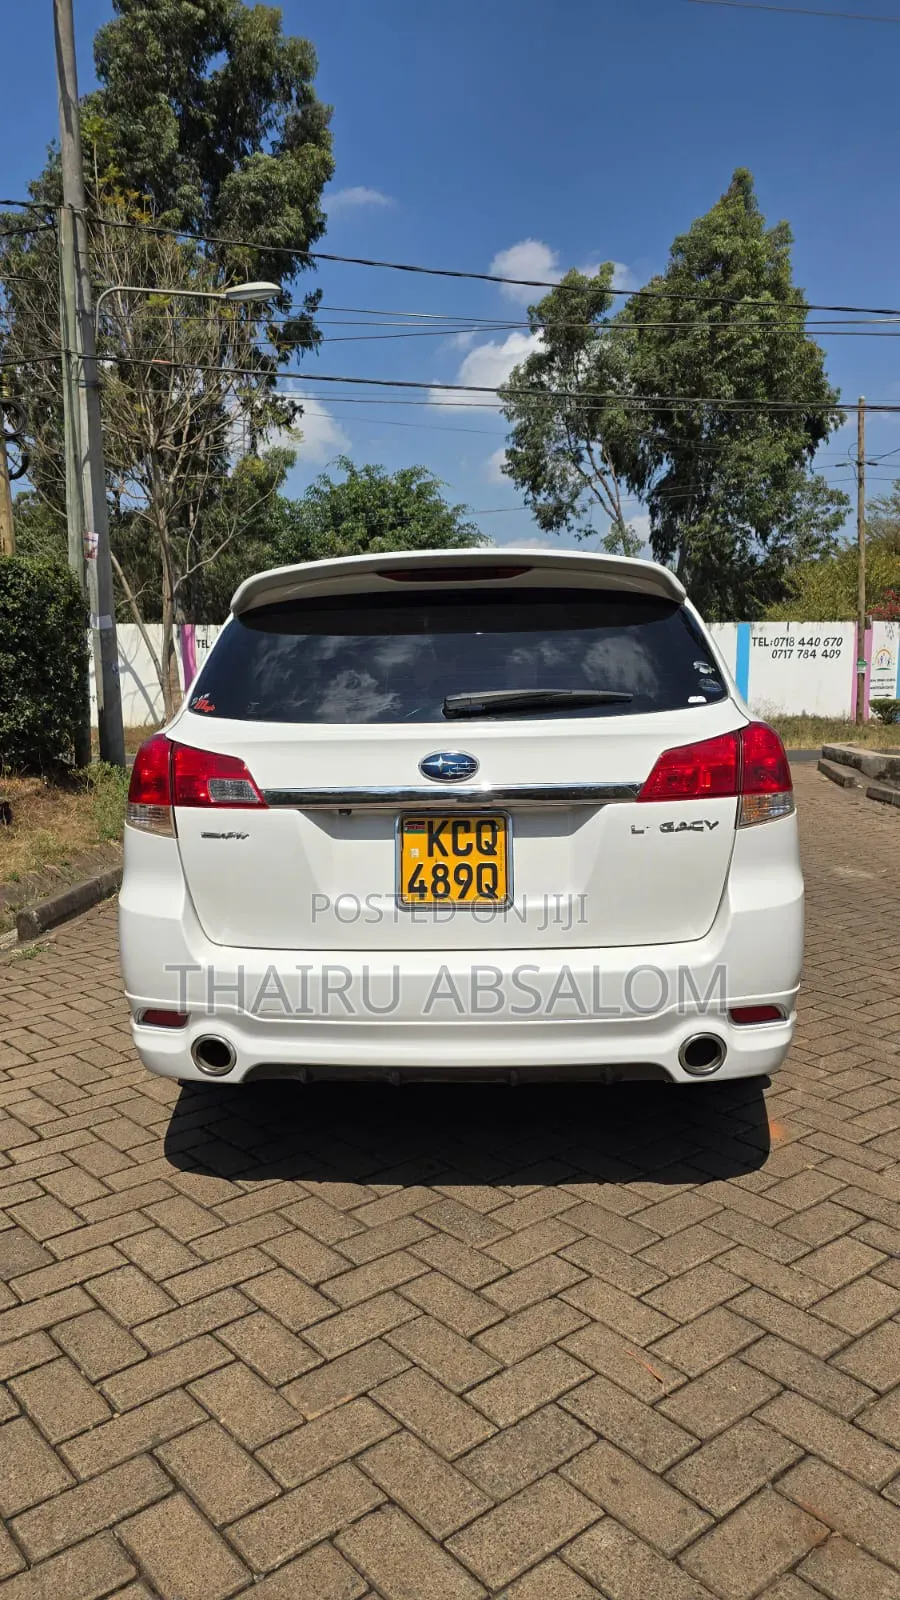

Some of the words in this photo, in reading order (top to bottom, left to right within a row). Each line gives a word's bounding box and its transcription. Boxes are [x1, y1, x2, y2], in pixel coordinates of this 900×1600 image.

[798, 637, 821, 647] 440
[823, 637, 843, 647] 670
[771, 649, 793, 659] 0717
[797, 649, 817, 659] 784
[821, 649, 841, 659] 409
[631, 820, 719, 834] LGACY
[427, 820, 498, 857] KCQ
[408, 862, 498, 900] 489Q
